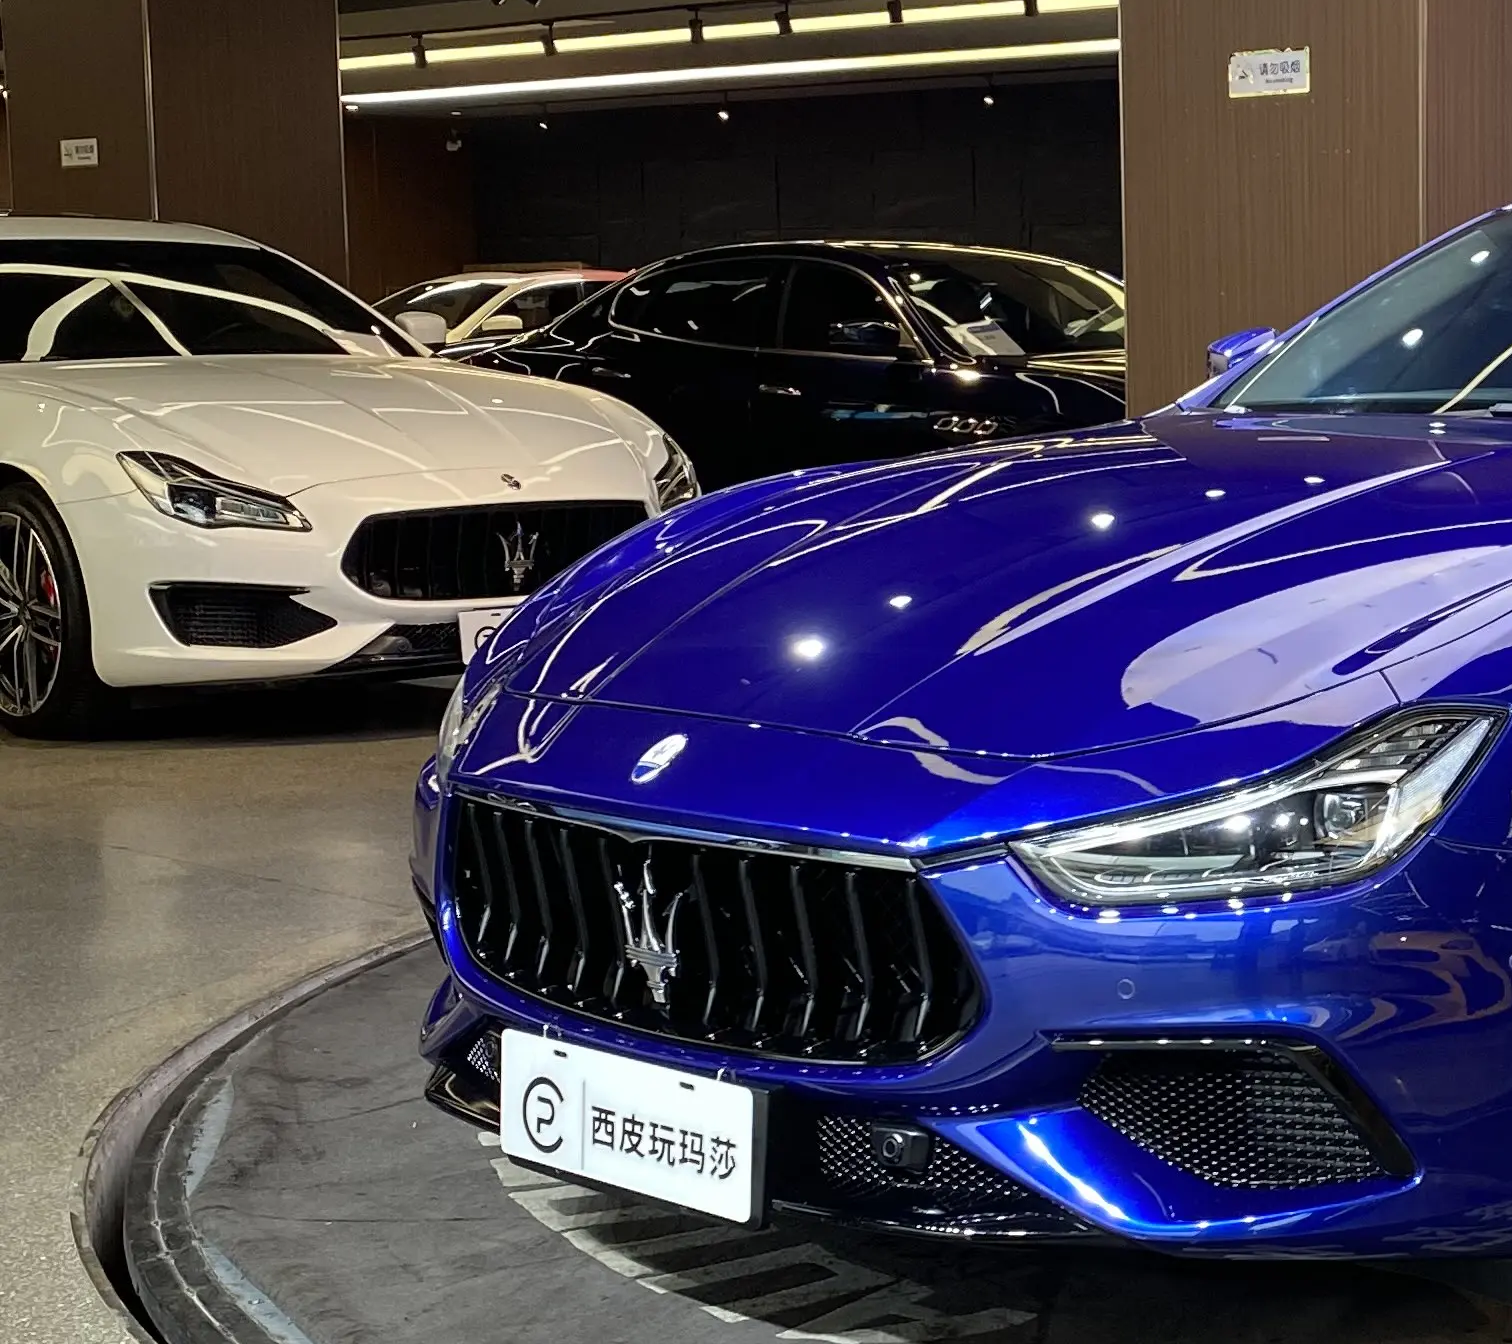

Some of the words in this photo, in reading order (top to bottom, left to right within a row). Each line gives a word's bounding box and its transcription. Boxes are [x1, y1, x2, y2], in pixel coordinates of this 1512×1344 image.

[1259, 60, 1301, 76] 请勿吸烟
[590, 1104, 740, 1181] 西皮玩玛莎
